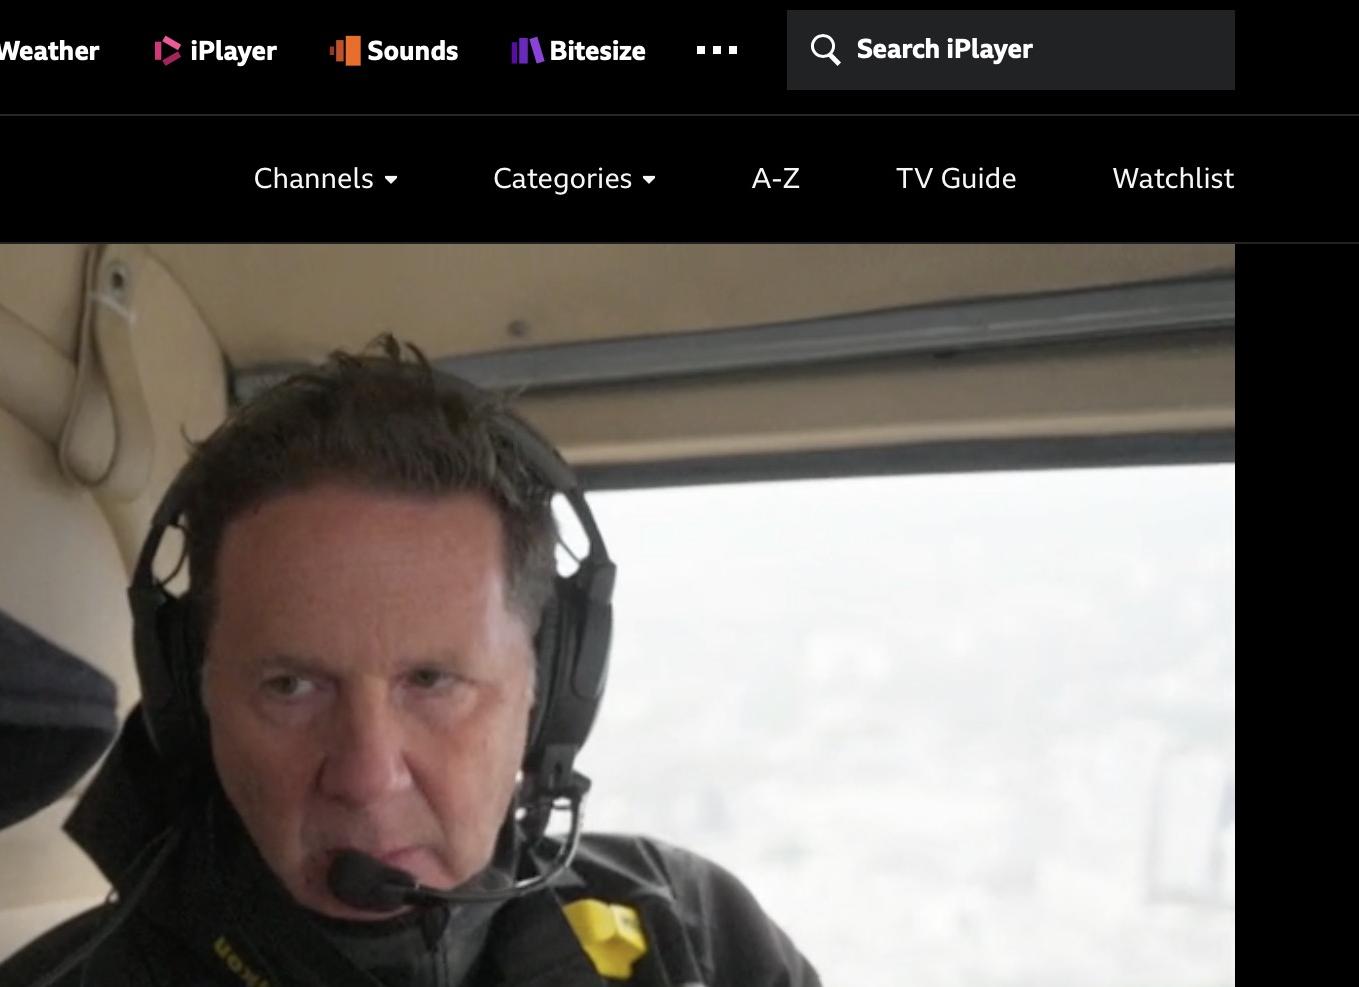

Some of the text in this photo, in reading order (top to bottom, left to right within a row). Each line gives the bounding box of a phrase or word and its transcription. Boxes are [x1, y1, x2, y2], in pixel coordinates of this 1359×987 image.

[190, 39, 278, 67] iPlayer
[367, 39, 459, 61] Sounds
[550, 39, 646, 61] Bitesize
[857, 37, 1034, 65] Search iPlayer
[254, 166, 374, 190] Channels
[493, 166, 632, 196] Categories
[751, 167, 800, 189] A-Z
[895, 166, 1017, 190] TV Guide
[1112, 166, 1235, 190] Watchlist
